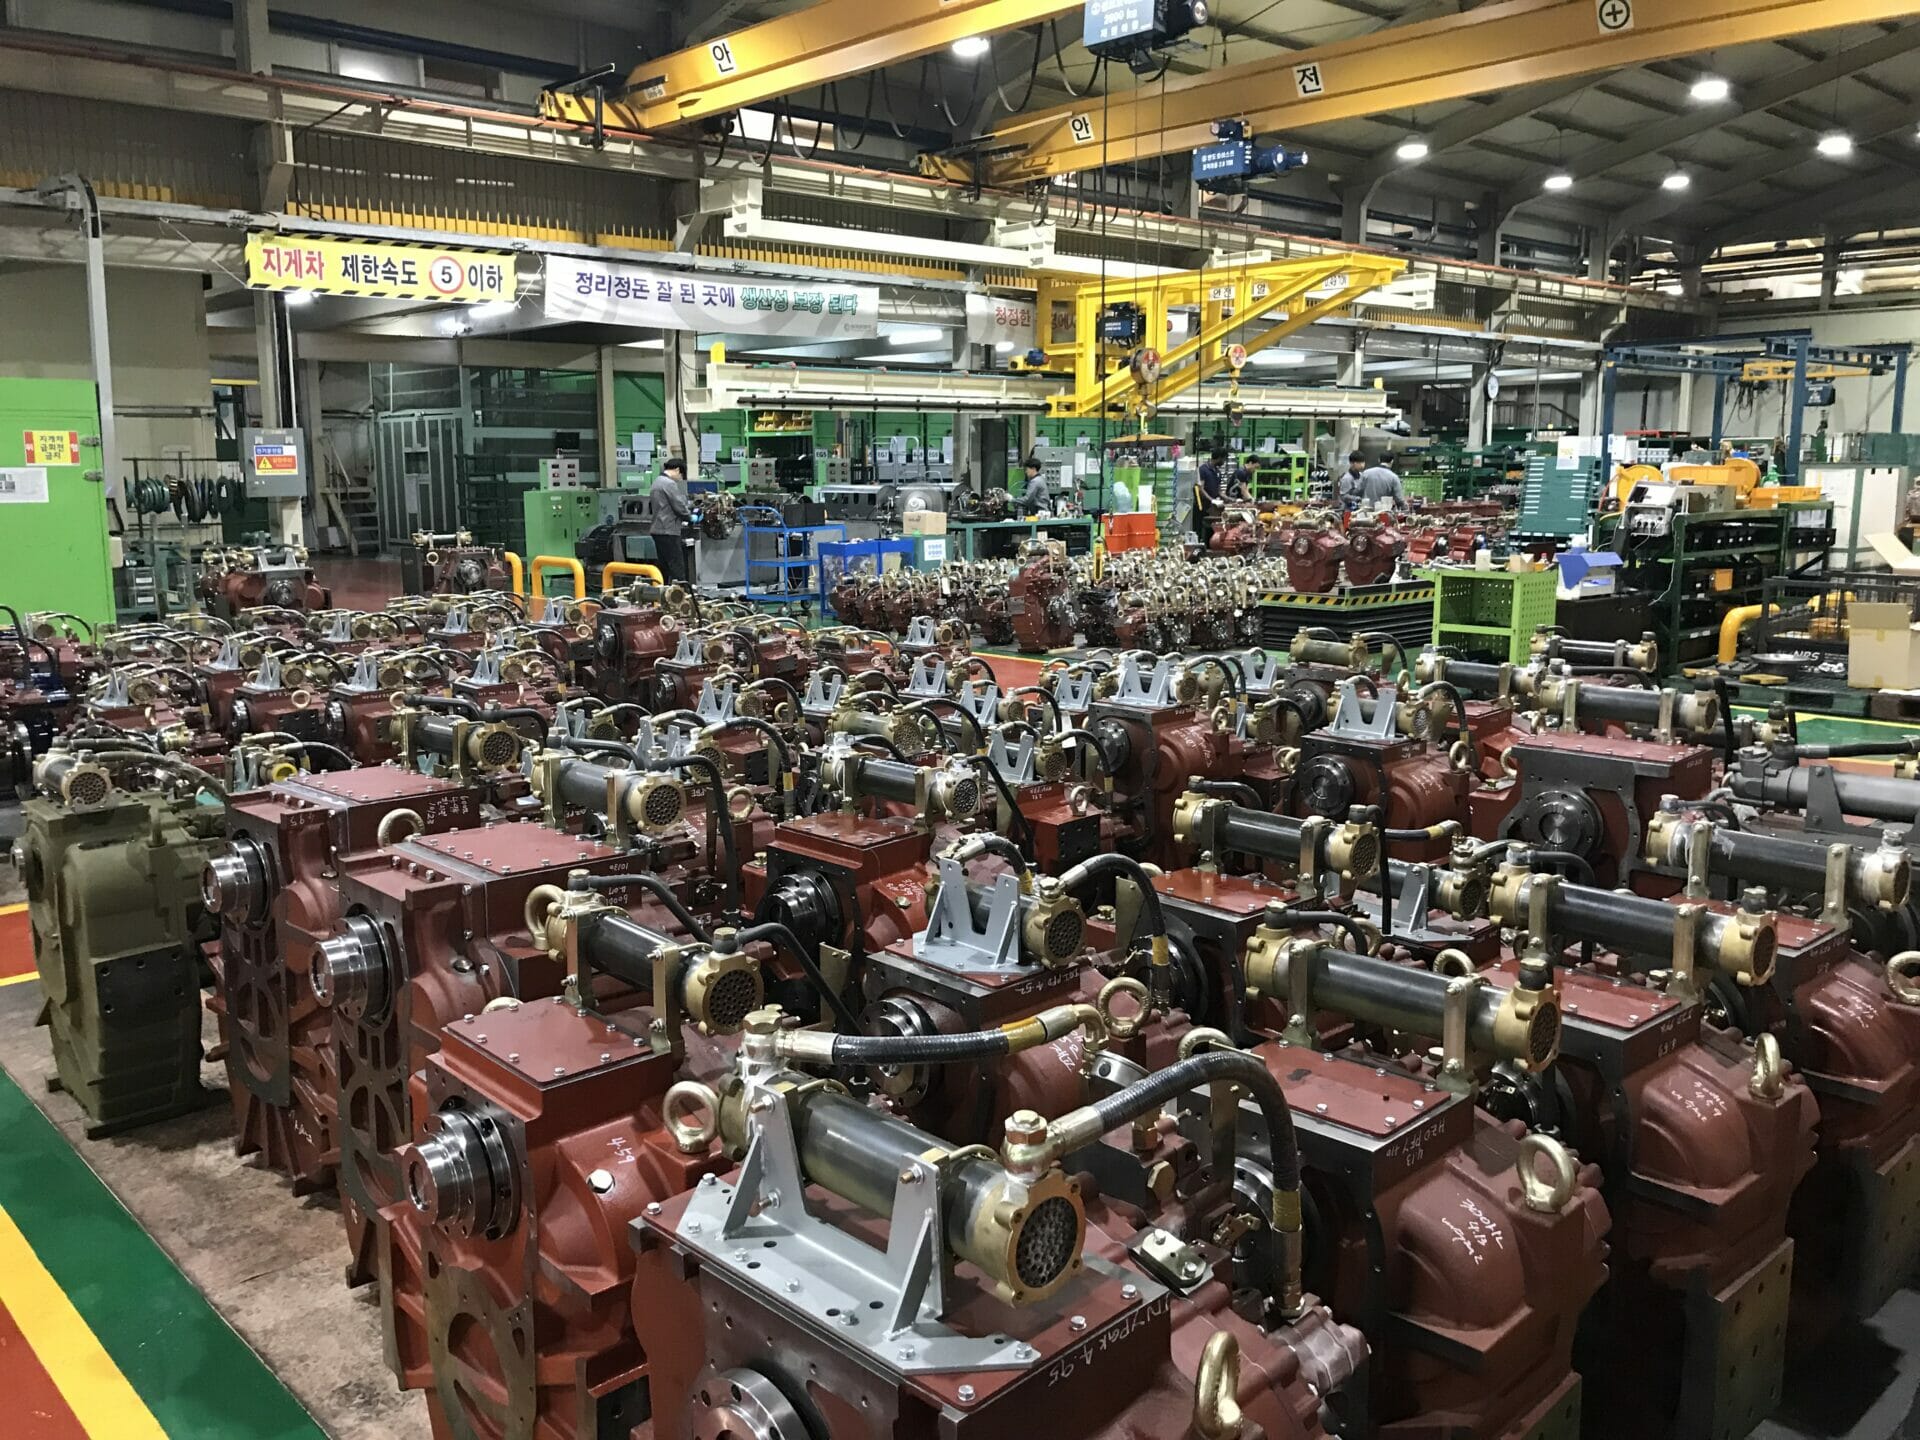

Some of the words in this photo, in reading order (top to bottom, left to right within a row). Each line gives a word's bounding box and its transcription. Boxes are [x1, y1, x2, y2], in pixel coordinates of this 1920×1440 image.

[712, 42, 734, 72] 안
[1071, 116, 1091, 141] 안
[1296, 65, 1322, 94] 전
[262, 247, 325, 280] 지게차
[341, 254, 419, 286] 제한속도
[441, 265, 452, 284] 5
[468, 264, 503, 293] 이하
[575, 271, 651, 301] 정리정돈
[656, 280, 673, 302] 잘
[679, 282, 696, 304] 된
[701, 284, 736, 308] 곳에
[740, 286, 790, 311] 생산성
[791, 290, 824, 315] 보장
[828, 292, 859, 315] 된다
[995, 306, 1031, 327] 청정한
